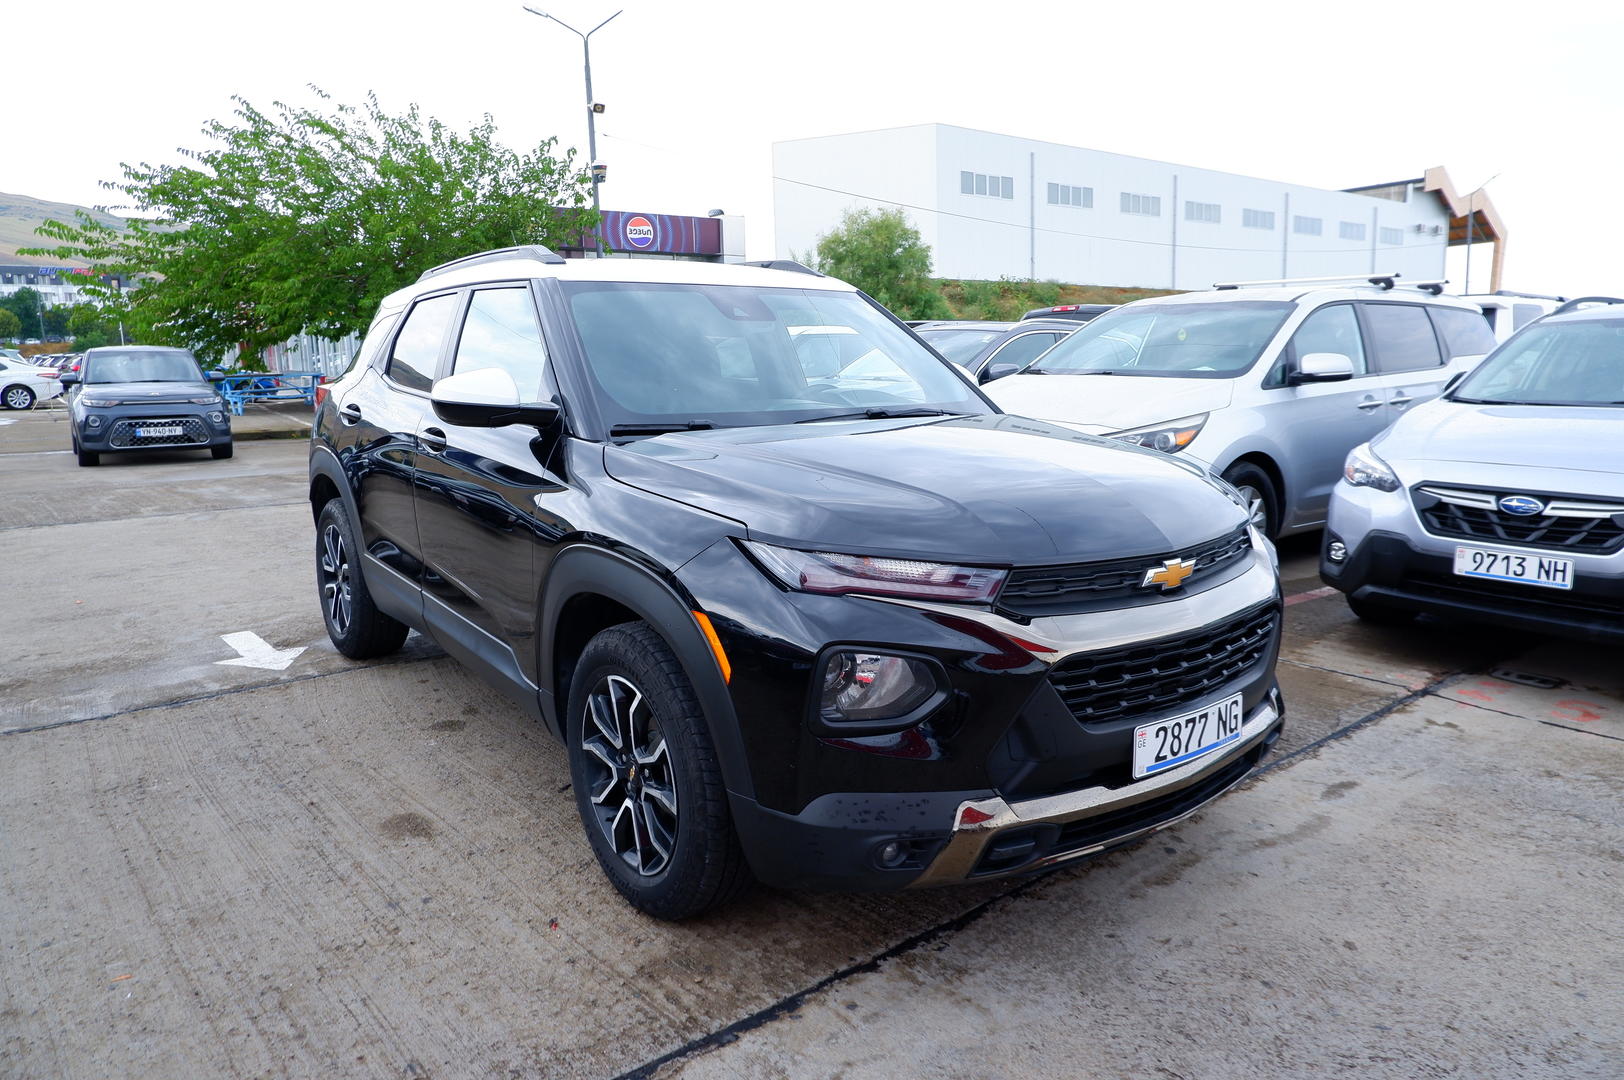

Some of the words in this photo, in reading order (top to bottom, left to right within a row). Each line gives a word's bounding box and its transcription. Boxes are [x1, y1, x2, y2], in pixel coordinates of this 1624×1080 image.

[1472, 551, 1526, 577] 9713
[1537, 557, 1567, 582] NH
[1138, 739, 1146, 749] GE
[1154, 711, 1208, 763] 2877
[1217, 700, 1239, 740] NG
